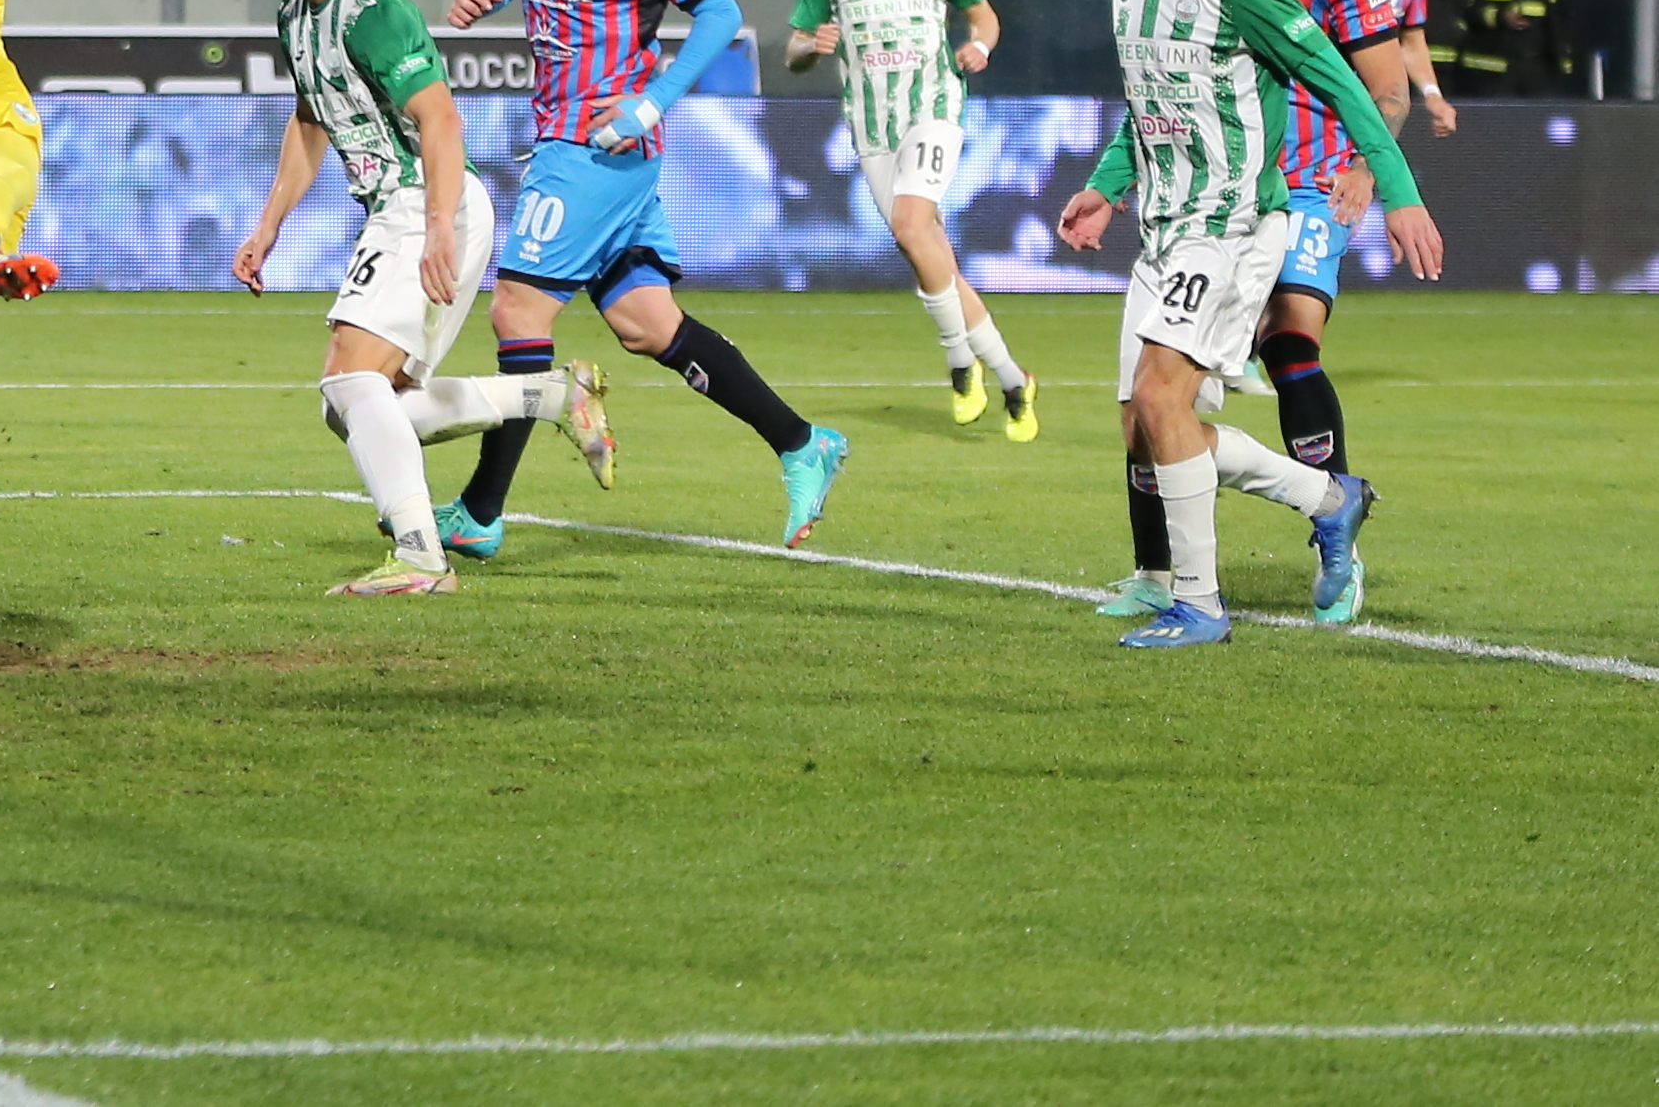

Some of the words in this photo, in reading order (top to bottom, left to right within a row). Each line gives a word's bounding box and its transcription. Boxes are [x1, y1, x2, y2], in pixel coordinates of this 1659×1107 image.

[865, 50, 920, 67] RODA
[1117, 43, 1154, 61] REEN
[1156, 47, 1202, 64] LINK
[1133, 83, 1155, 99] SUD
[1140, 115, 1188, 136] ODA
[916, 141, 944, 174] 18
[516, 190, 565, 242] 10
[1286, 211, 1331, 259] 13
[346, 247, 384, 287] 16
[1163, 271, 1210, 313] 20
